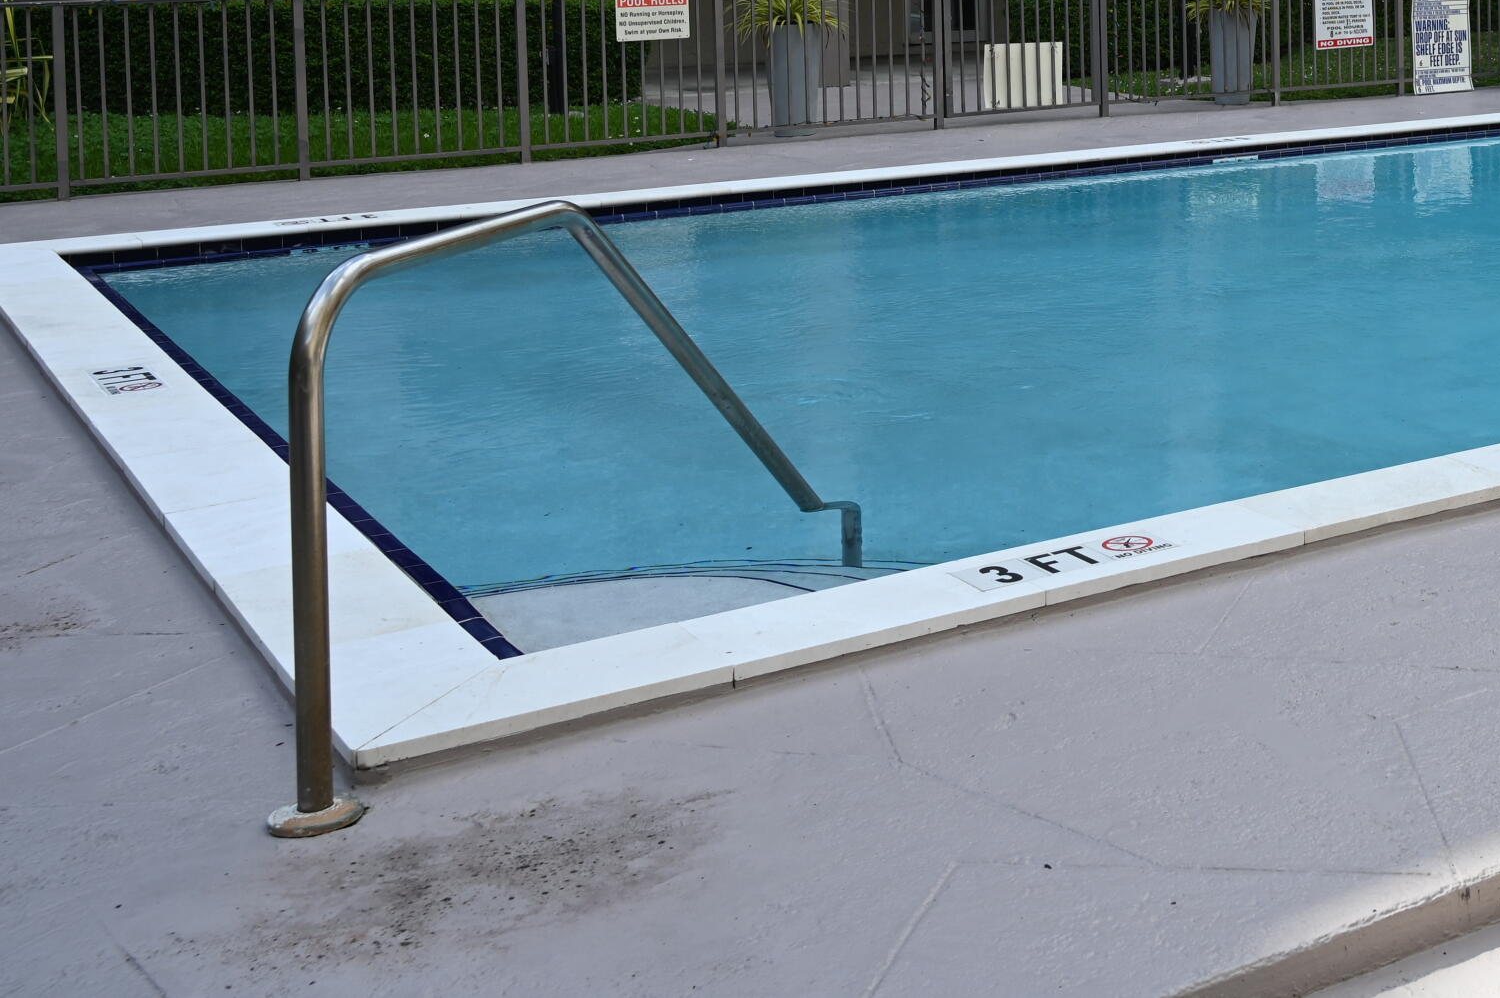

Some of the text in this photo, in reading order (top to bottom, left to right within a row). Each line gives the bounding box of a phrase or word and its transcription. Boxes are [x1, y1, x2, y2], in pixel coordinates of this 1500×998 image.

[1415, 19, 1450, 31] WARNING:
[1416, 30, 1467, 44] DROP OFF AT SUN
[1416, 42, 1462, 56] SHELF EDGE IS
[1430, 55, 1443, 67] FEET
[1445, 54, 1460, 66] DEEP.
[1133, 543, 1173, 554] DIVING
[979, 545, 1100, 583] 3 FT
